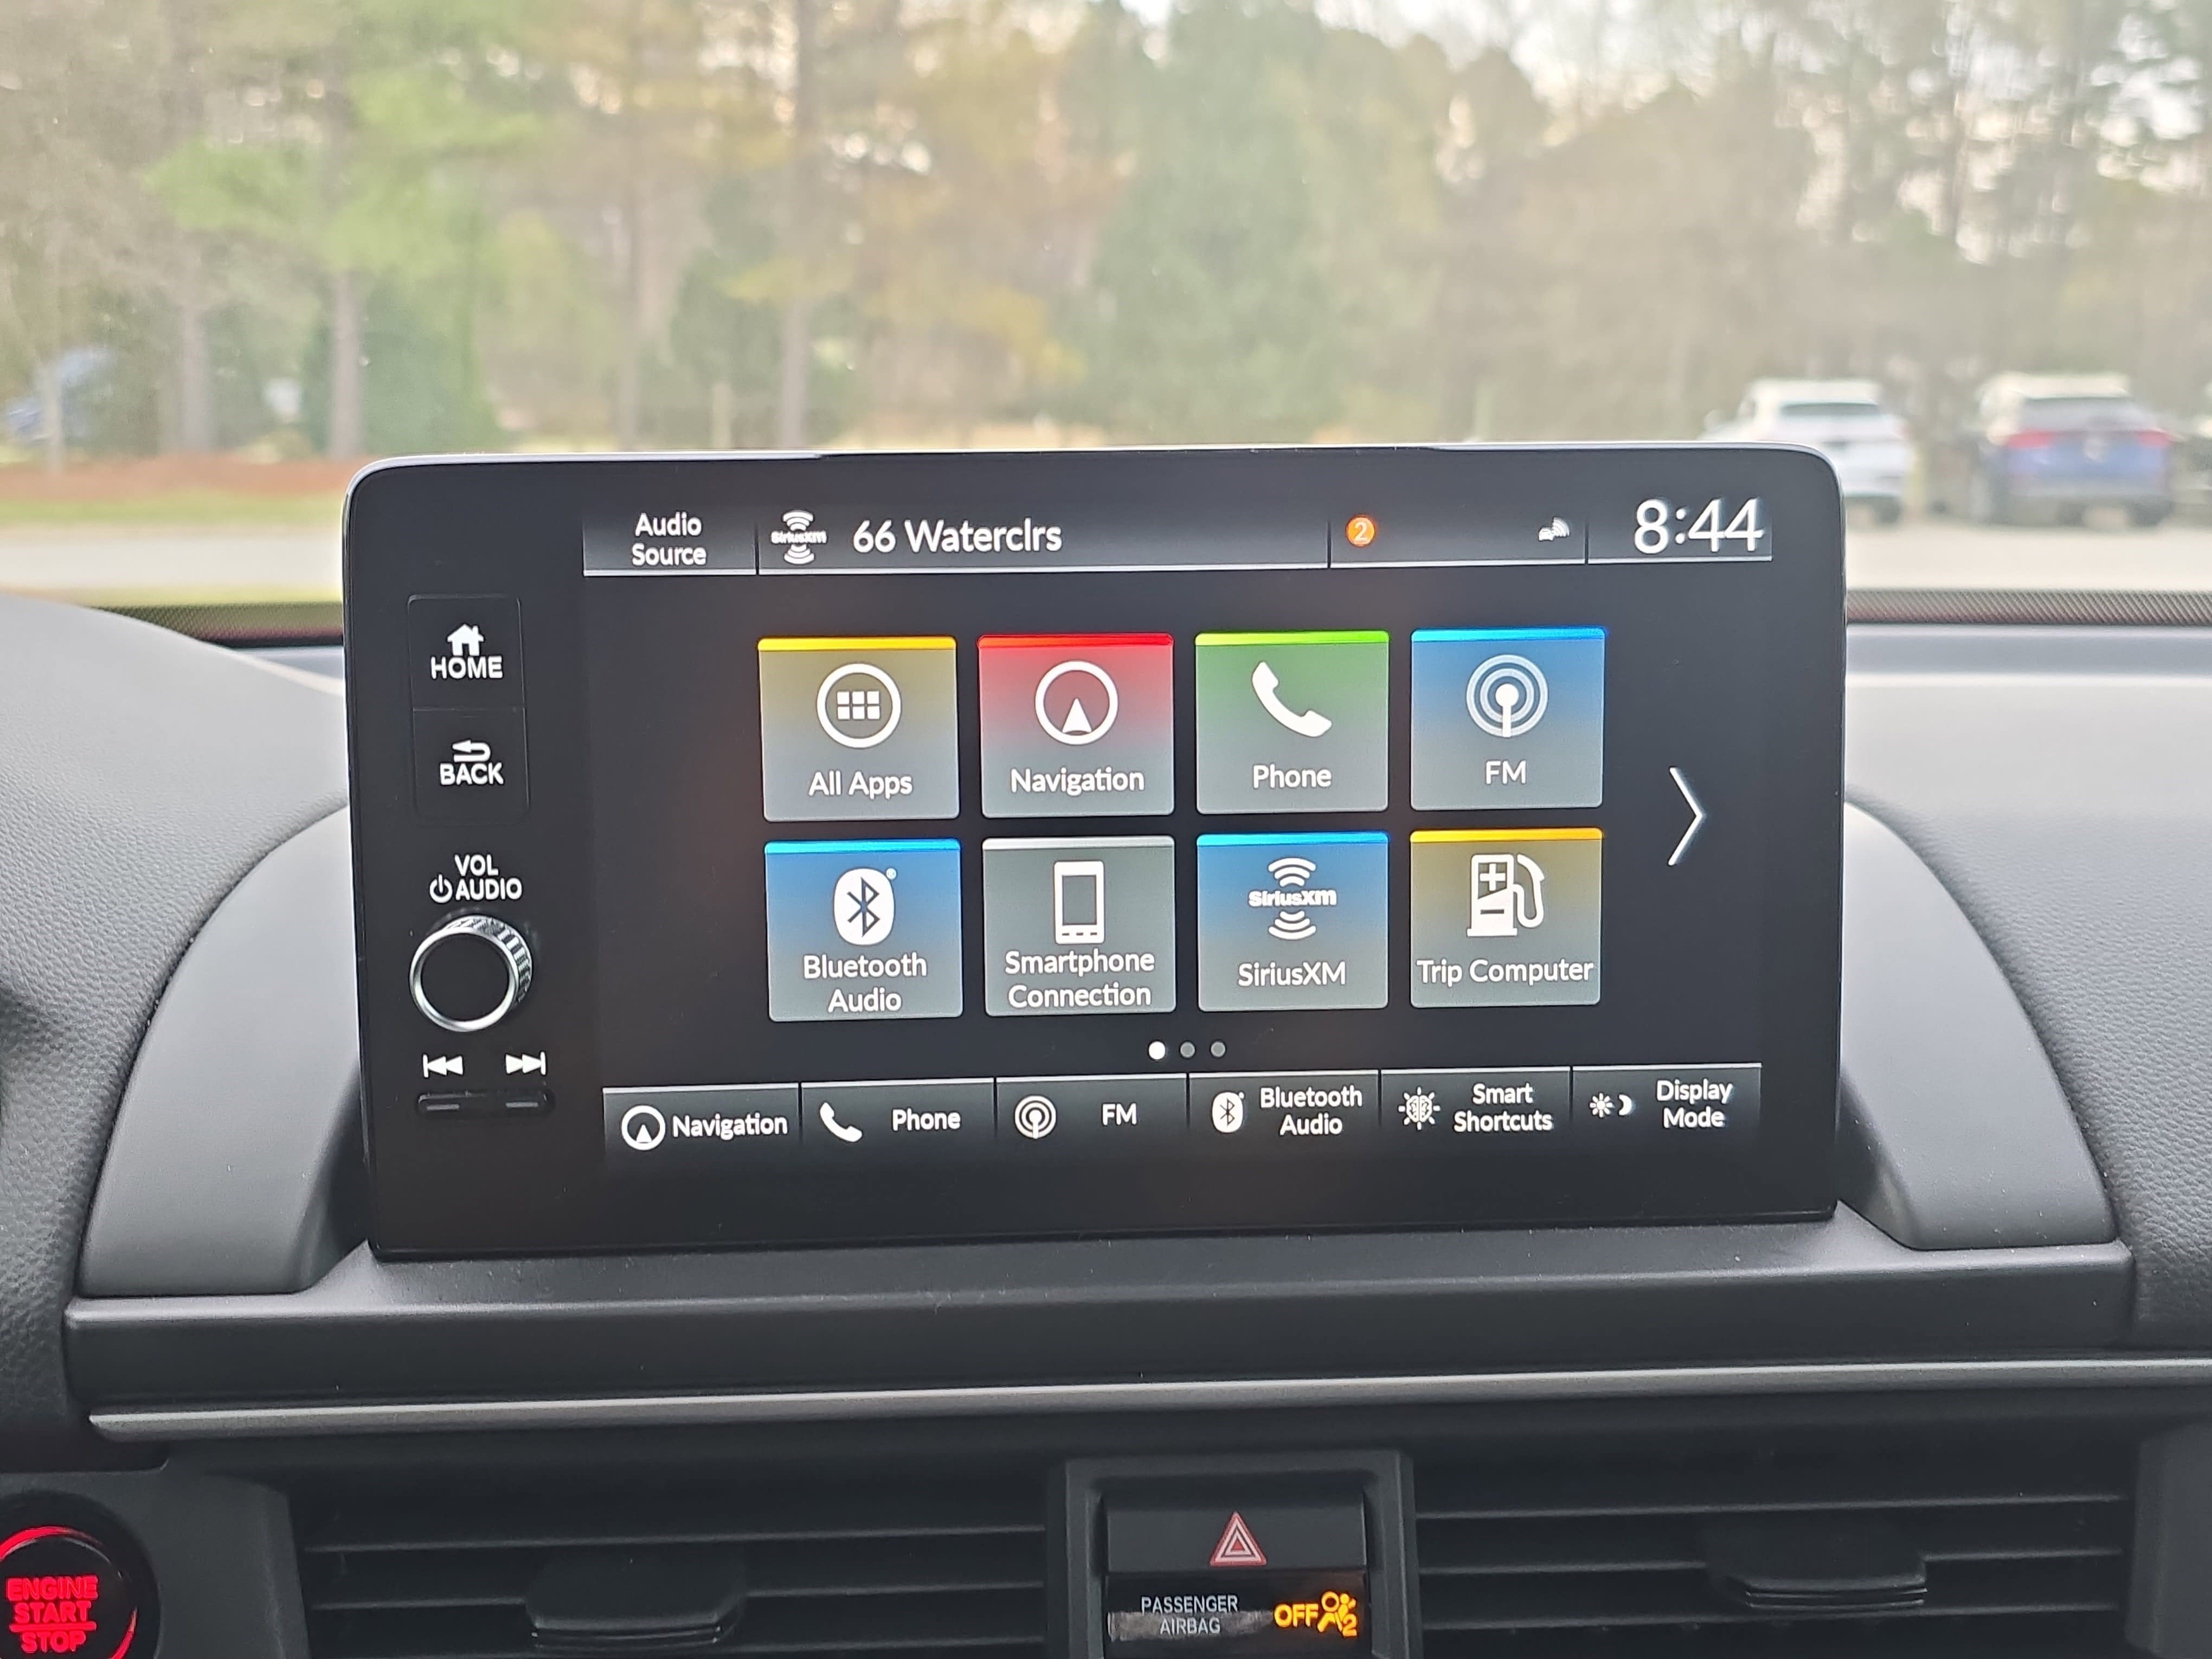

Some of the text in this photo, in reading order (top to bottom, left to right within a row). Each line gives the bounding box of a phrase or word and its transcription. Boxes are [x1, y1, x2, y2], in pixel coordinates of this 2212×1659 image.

[635, 511, 702, 536] Audio
[853, 518, 1062, 553] 66 Waterclrs
[1353, 522, 1368, 541] 2
[1634, 498, 1764, 554] 8:44
[632, 543, 707, 566] Source
[430, 655, 503, 679] HOME
[440, 762, 504, 785] BACK
[1011, 766, 1144, 796] Navigation
[1253, 764, 1332, 788] Phone
[1486, 760, 1526, 784] FM
[808, 770, 912, 800] All Apps
[454, 854, 499, 877] VOL
[455, 878, 522, 901] AUDIO
[803, 951, 927, 979] Bluetooth
[1005, 949, 1155, 977] Smartphone
[1238, 961, 1346, 987] SiriusXM
[1416, 959, 1594, 987] Trip Computer
[828, 987, 902, 1013] Audio
[1008, 983, 1153, 1009] Connection
[1261, 1086, 1362, 1108] Bluetooth
[1472, 1083, 1534, 1104] Smart
[1657, 1078, 1733, 1104] Display
[672, 1113, 788, 1140] Navigation
[892, 1108, 961, 1131] Phone
[1102, 1103, 1137, 1126] FM
[1279, 1114, 1343, 1135] Audio
[1454, 1110, 1553, 1132] Shortcuts
[1663, 1107, 1726, 1128] Mode
[7, 1576, 99, 1600] ENGINE
[15, 1600, 92, 1623] START
[1141, 1595, 1239, 1614] PASSENGER
[1274, 1603, 1319, 1627] OFF
[1160, 1617, 1220, 1635] AIRBAG
[22, 1630, 86, 1653] STOP
